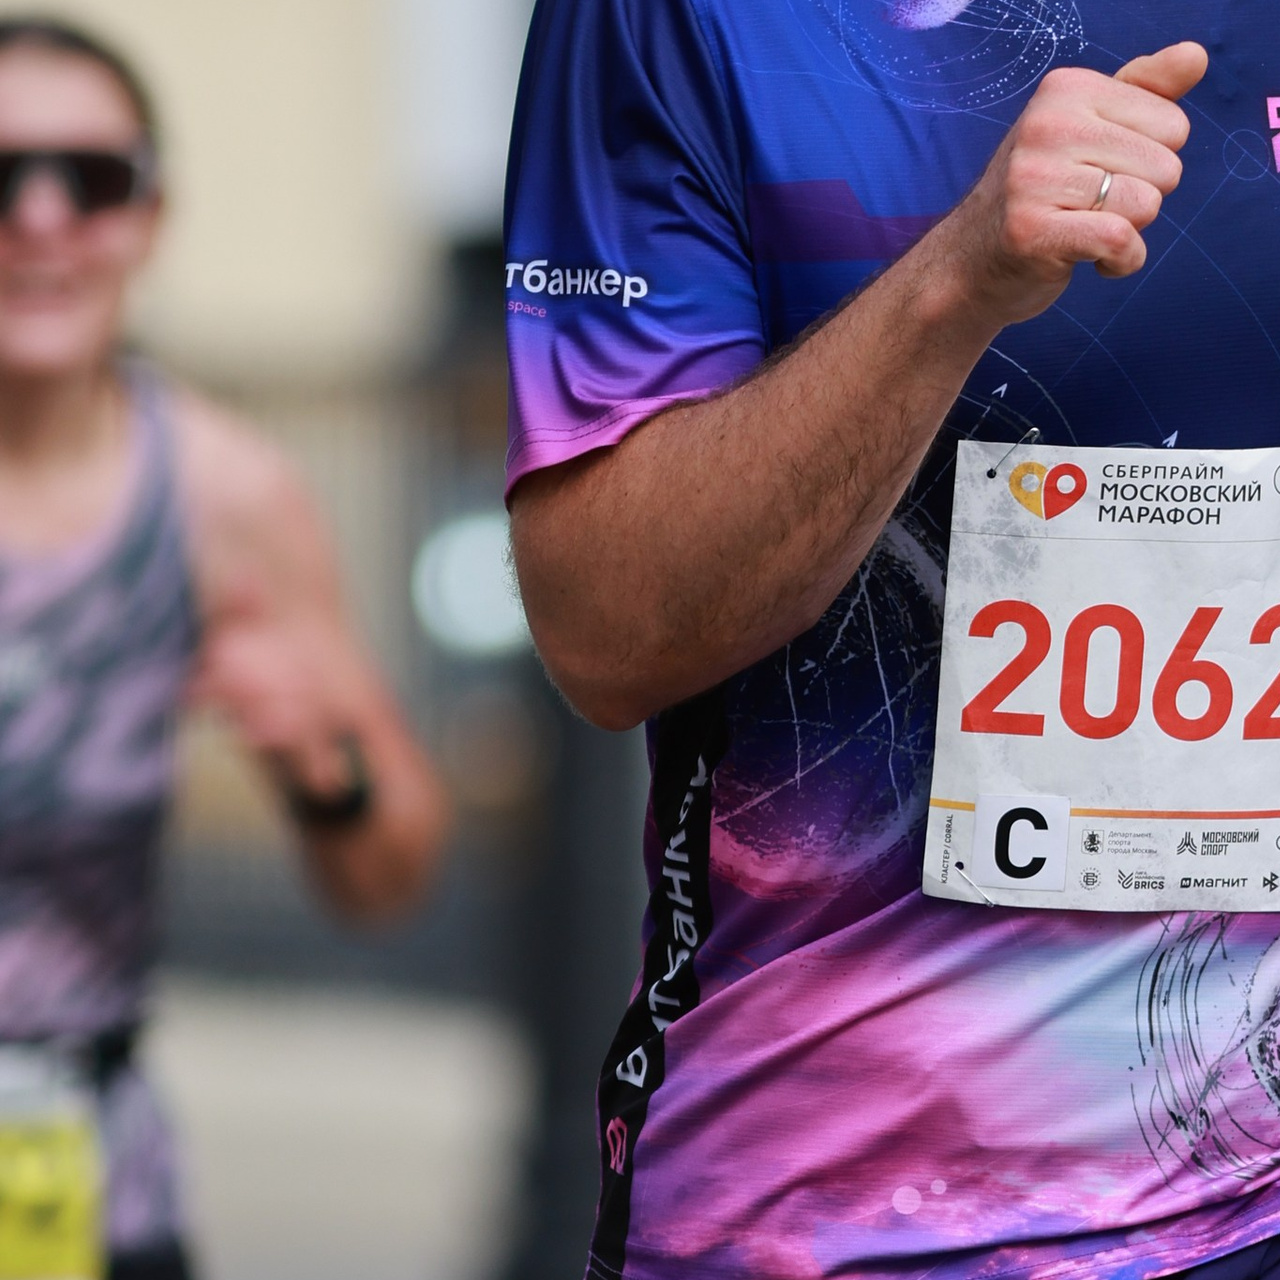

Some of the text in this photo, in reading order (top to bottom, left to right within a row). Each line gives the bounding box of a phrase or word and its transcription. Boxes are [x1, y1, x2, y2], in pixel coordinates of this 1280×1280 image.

[505, 259, 648, 308] тбанкер
[507, 300, 547, 318] space
[1102, 463, 1224, 480] СБЕРПРАЙМ
[1100, 480, 1262, 503] МОСКОВСКИЙ
[1098, 505, 1221, 525] МАРАФОН
[945, 814, 954, 843] CORRAL
[1201, 828, 1259, 843] МОСКОВСКИЙ
[994, 806, 1049, 880] C
[1200, 844, 1229, 856] СПОРТ
[941, 849, 950, 884] КЛАСТЕР
[1133, 880, 1165, 889] BRICS
[1193, 878, 1248, 888] магнит
